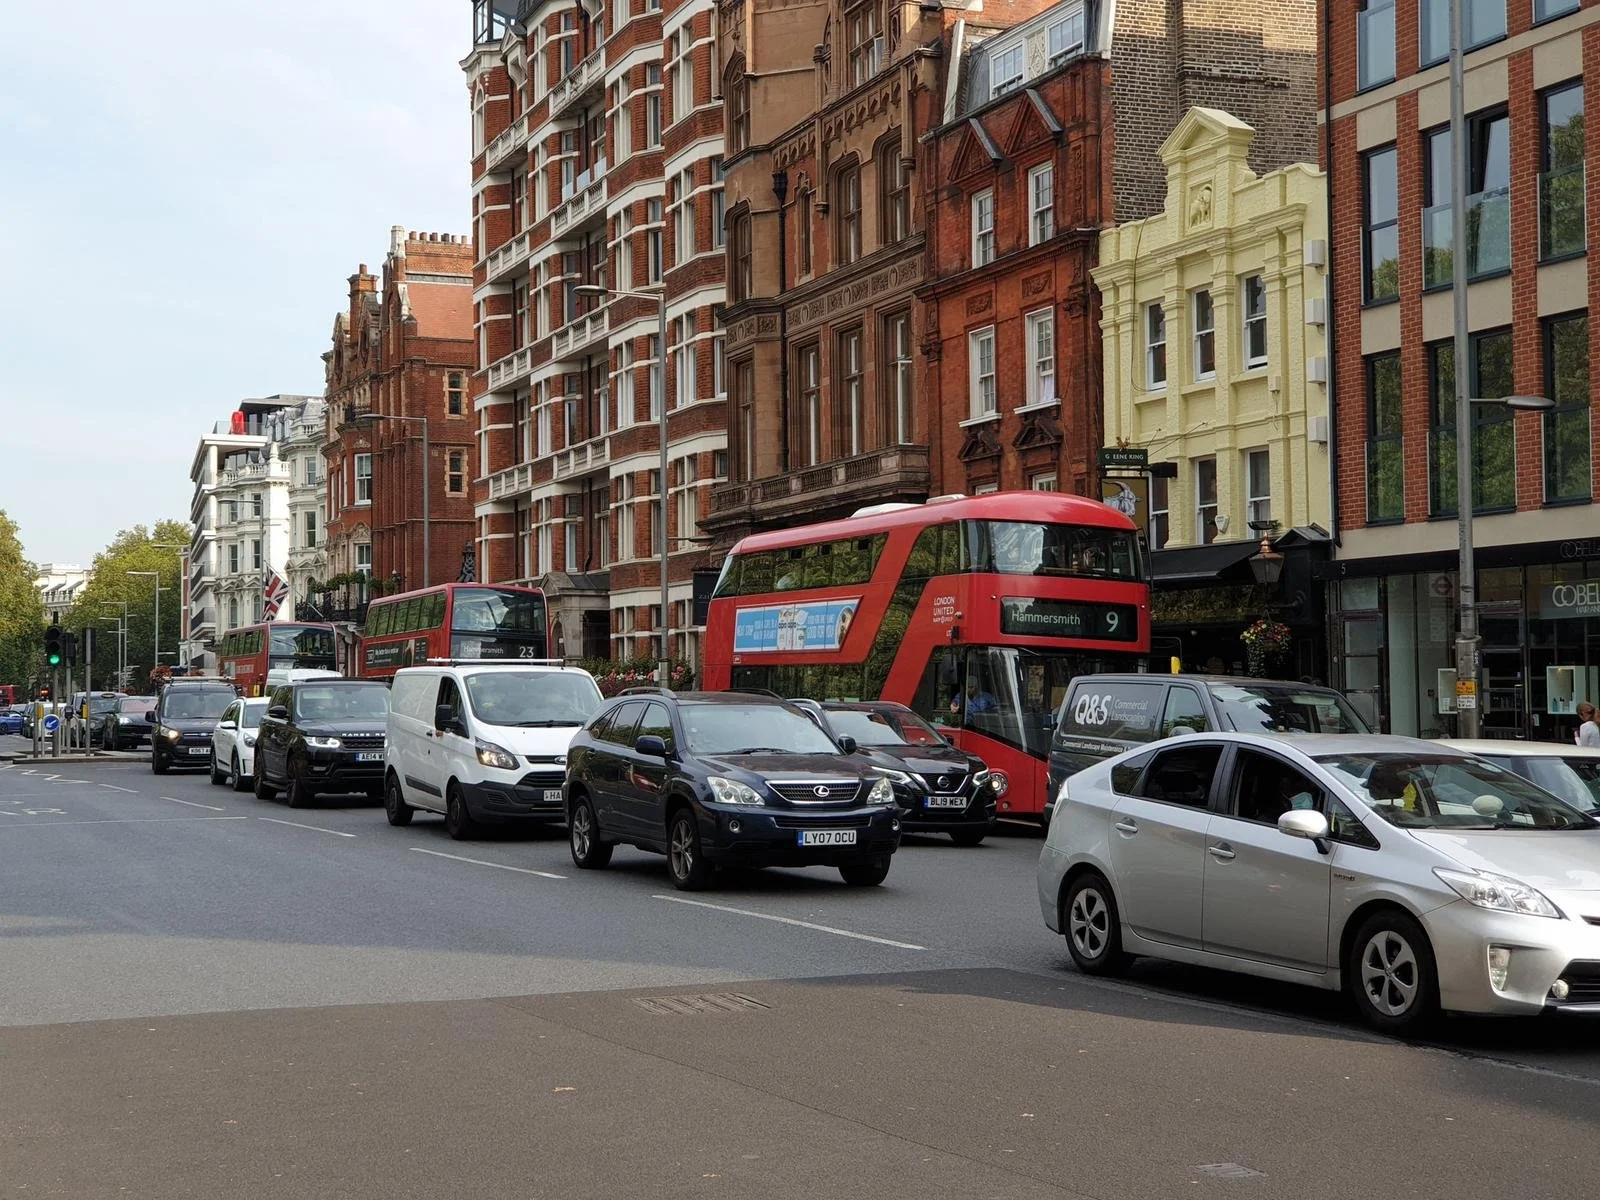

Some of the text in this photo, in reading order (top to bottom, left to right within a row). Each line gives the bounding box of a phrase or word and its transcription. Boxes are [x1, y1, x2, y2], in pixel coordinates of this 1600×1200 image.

[934, 596, 955, 606] LONDON
[933, 606, 954, 616] UNITED
[1011, 610, 1119, 632] Hammersmith 9
[463, 646, 534, 658] Hammersmith 23
[1075, 694, 1112, 725] Q&S
[930, 797, 947, 806] BL19
[804, 832, 855, 844] LY07 OCU
